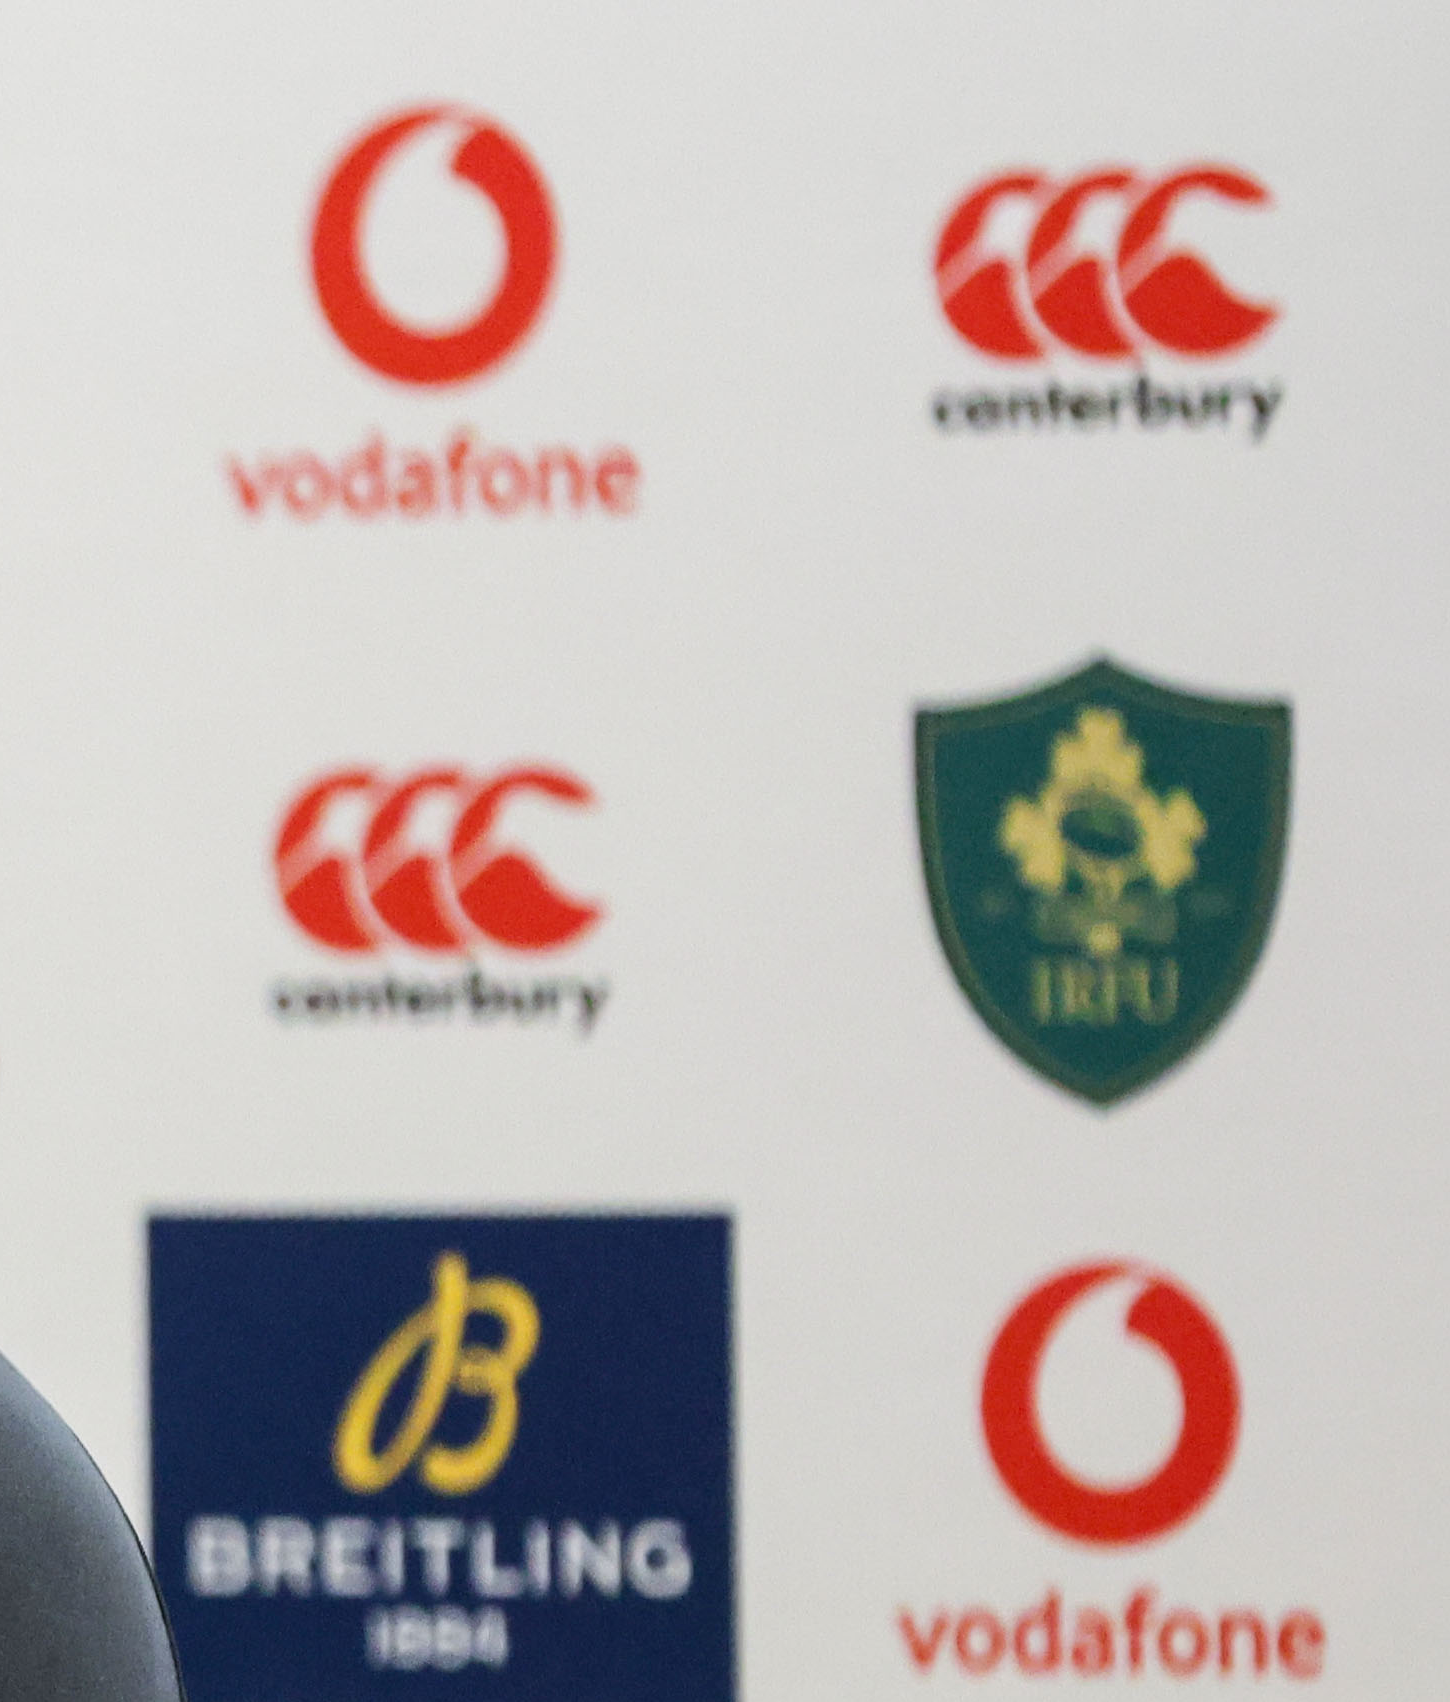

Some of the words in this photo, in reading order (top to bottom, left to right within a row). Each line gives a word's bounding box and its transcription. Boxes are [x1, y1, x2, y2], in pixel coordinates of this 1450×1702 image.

[930, 370, 1283, 440] canterbury
[226, 424, 643, 520] vodafone
[270, 962, 609, 1034] canterbury
[1031, 953, 1181, 1025] IRFU
[185, 1513, 694, 1602] BREITLING
[896, 1584, 1328, 1682] vodafone
